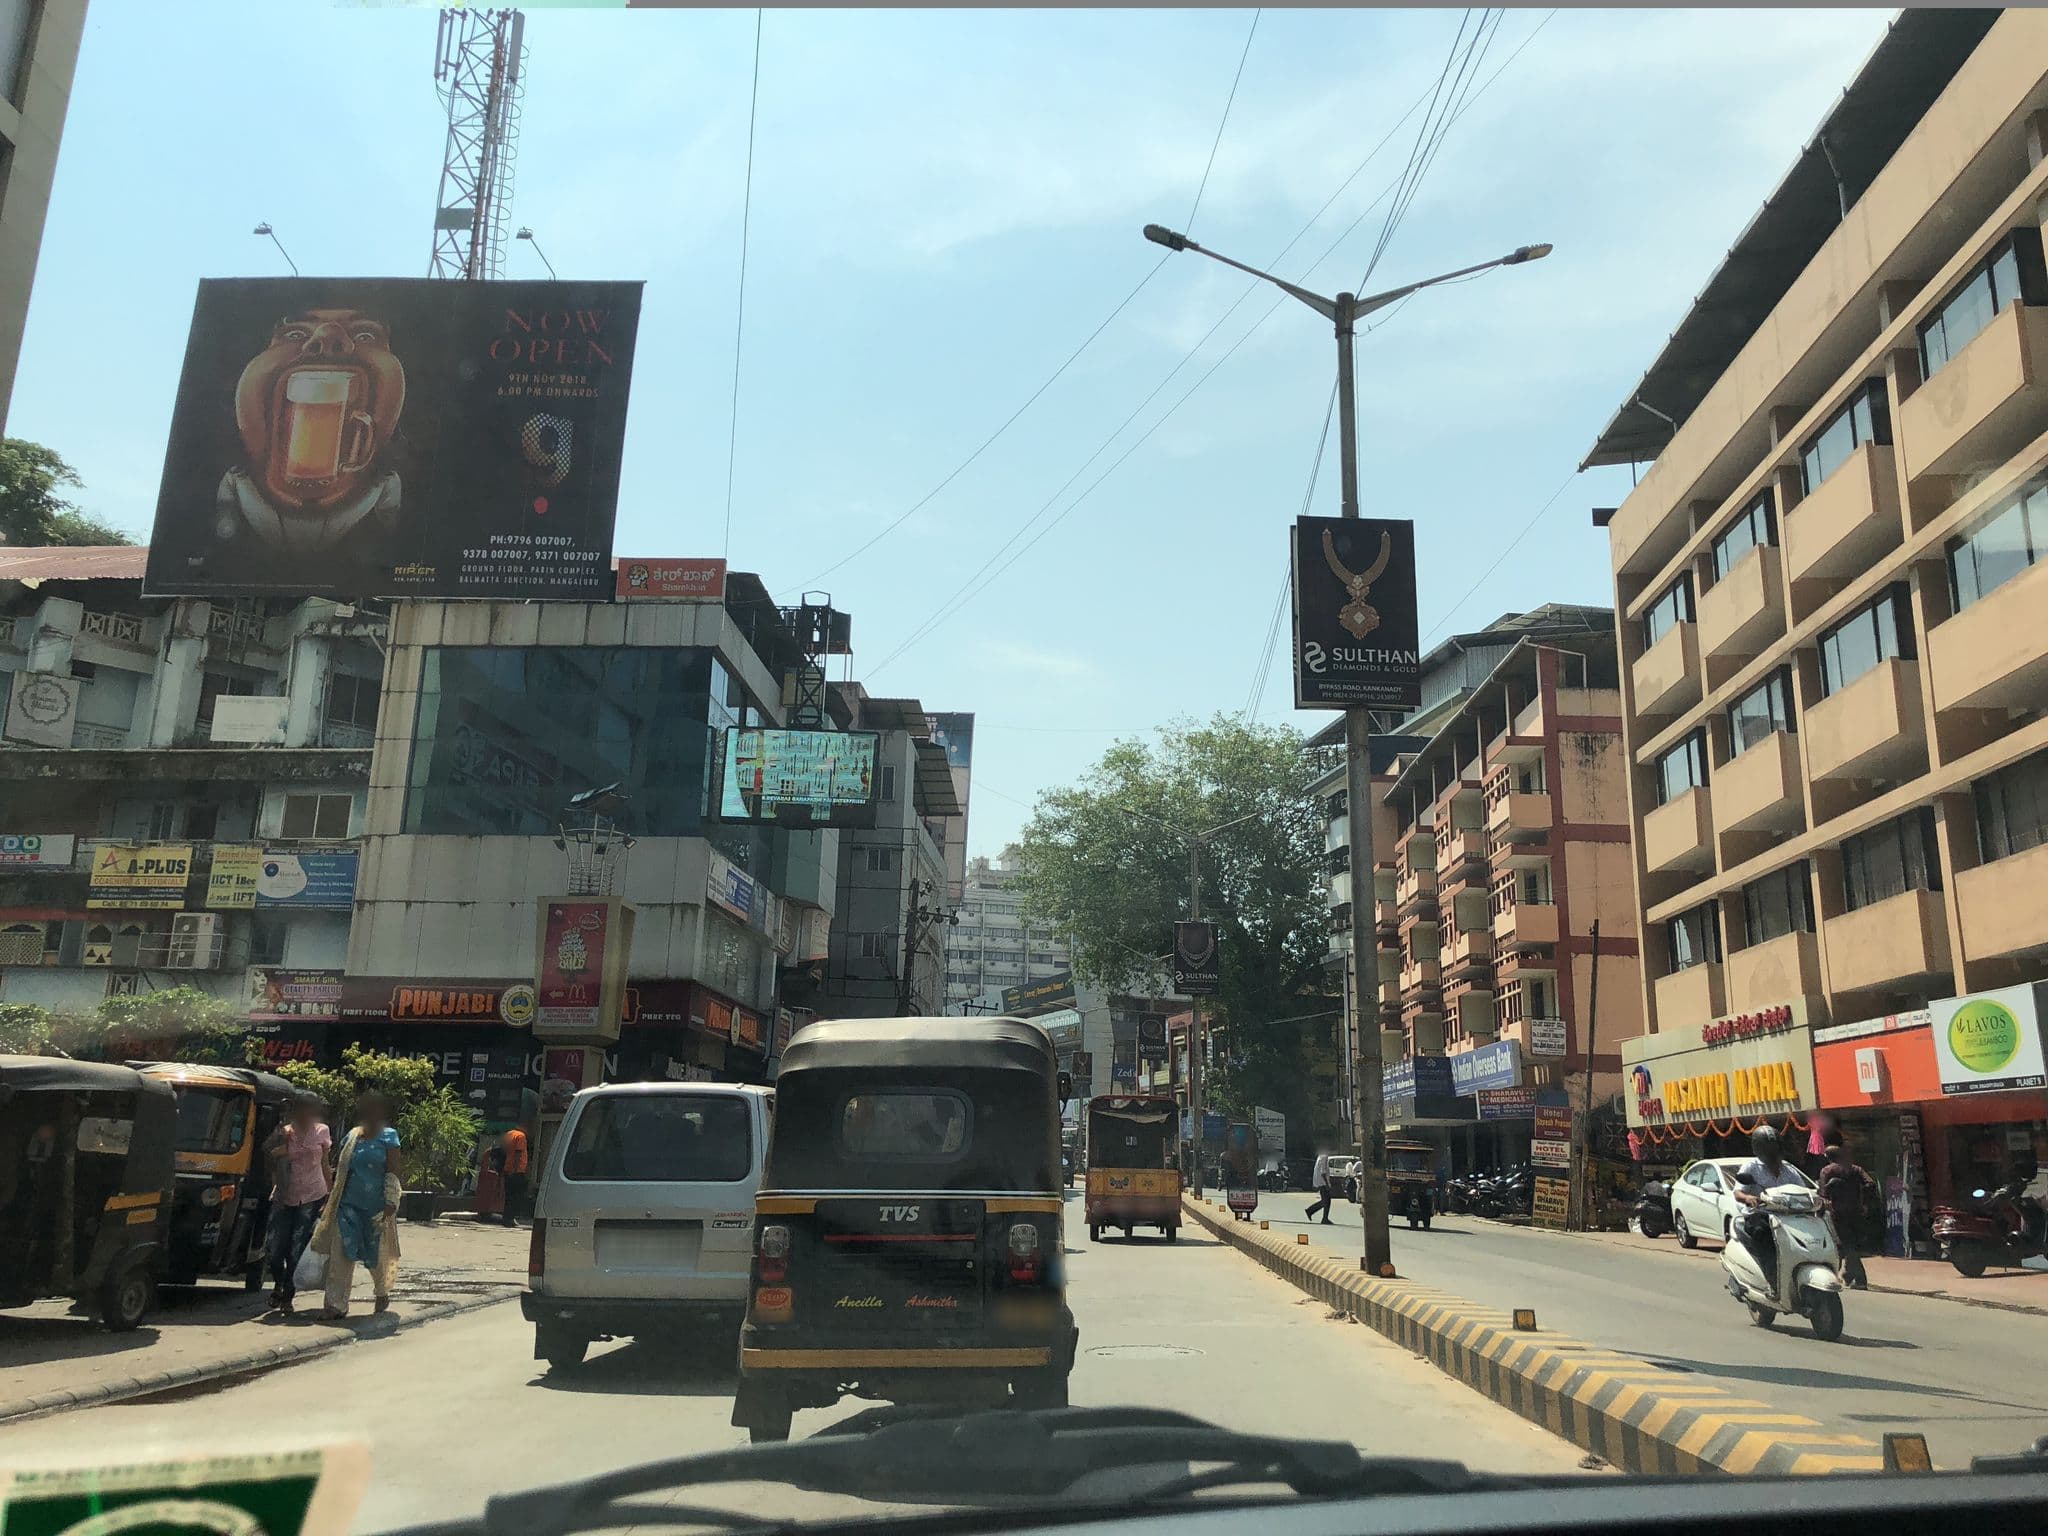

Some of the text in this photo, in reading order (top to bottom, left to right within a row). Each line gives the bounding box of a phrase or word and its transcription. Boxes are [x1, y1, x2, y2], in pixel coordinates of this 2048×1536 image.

[504, 309, 609, 333] NOW
[489, 338, 613, 365] OPEN
[535, 536, 576, 547] 007007,
[463, 549, 600, 561] 9378 007007, 9371 007007
[1332, 647, 1418, 665] SULTHAN
[1333, 663, 1382, 672] DIAMONDS
[1393, 665, 1418, 674] GOLD
[127, 858, 187, 875] A-PLUS
[397, 988, 493, 1017] PUNJABI
[1664, 1061, 1798, 1114] VASANTH MAHAL
[1535, 1145, 1566, 1153] HOTEL
[879, 1205, 920, 1222] TVS
[834, 1295, 885, 1308] Ancilla
[904, 1295, 959, 1308] Ashmitha
